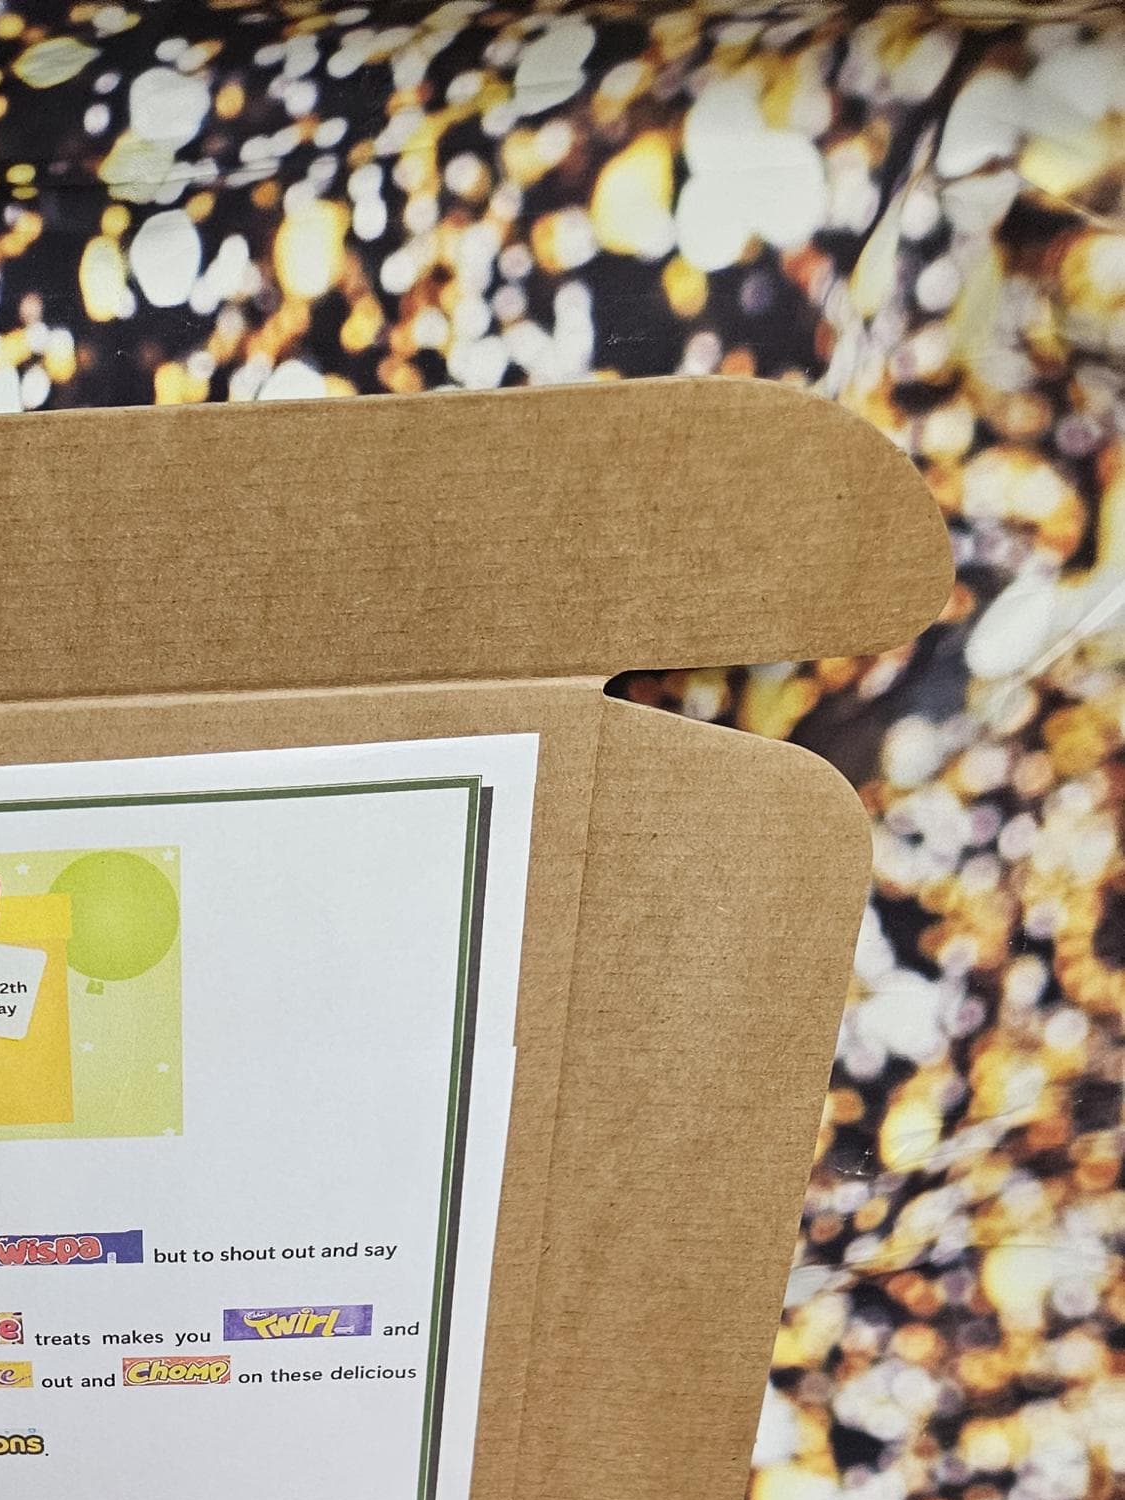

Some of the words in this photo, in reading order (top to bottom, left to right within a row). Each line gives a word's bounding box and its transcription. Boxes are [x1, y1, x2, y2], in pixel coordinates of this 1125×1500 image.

[154, 1246, 187, 1264] but
[193, 1248, 214, 1264] to
[220, 1245, 276, 1263] shout
[281, 1245, 316, 1261] out
[321, 1242, 358, 1259] and
[364, 1243, 398, 1261] say
[34, 1331, 91, 1347] treats
[102, 1329, 164, 1346] makes
[175, 1330, 211, 1348] you
[243, 1307, 341, 1339] Twirl
[383, 1321, 419, 1338] and
[41, 1374, 73, 1389] out
[81, 1372, 116, 1389] and
[238, 1370, 262, 1385] on
[270, 1366, 322, 1383] these
[330, 1363, 417, 1382] delicious
